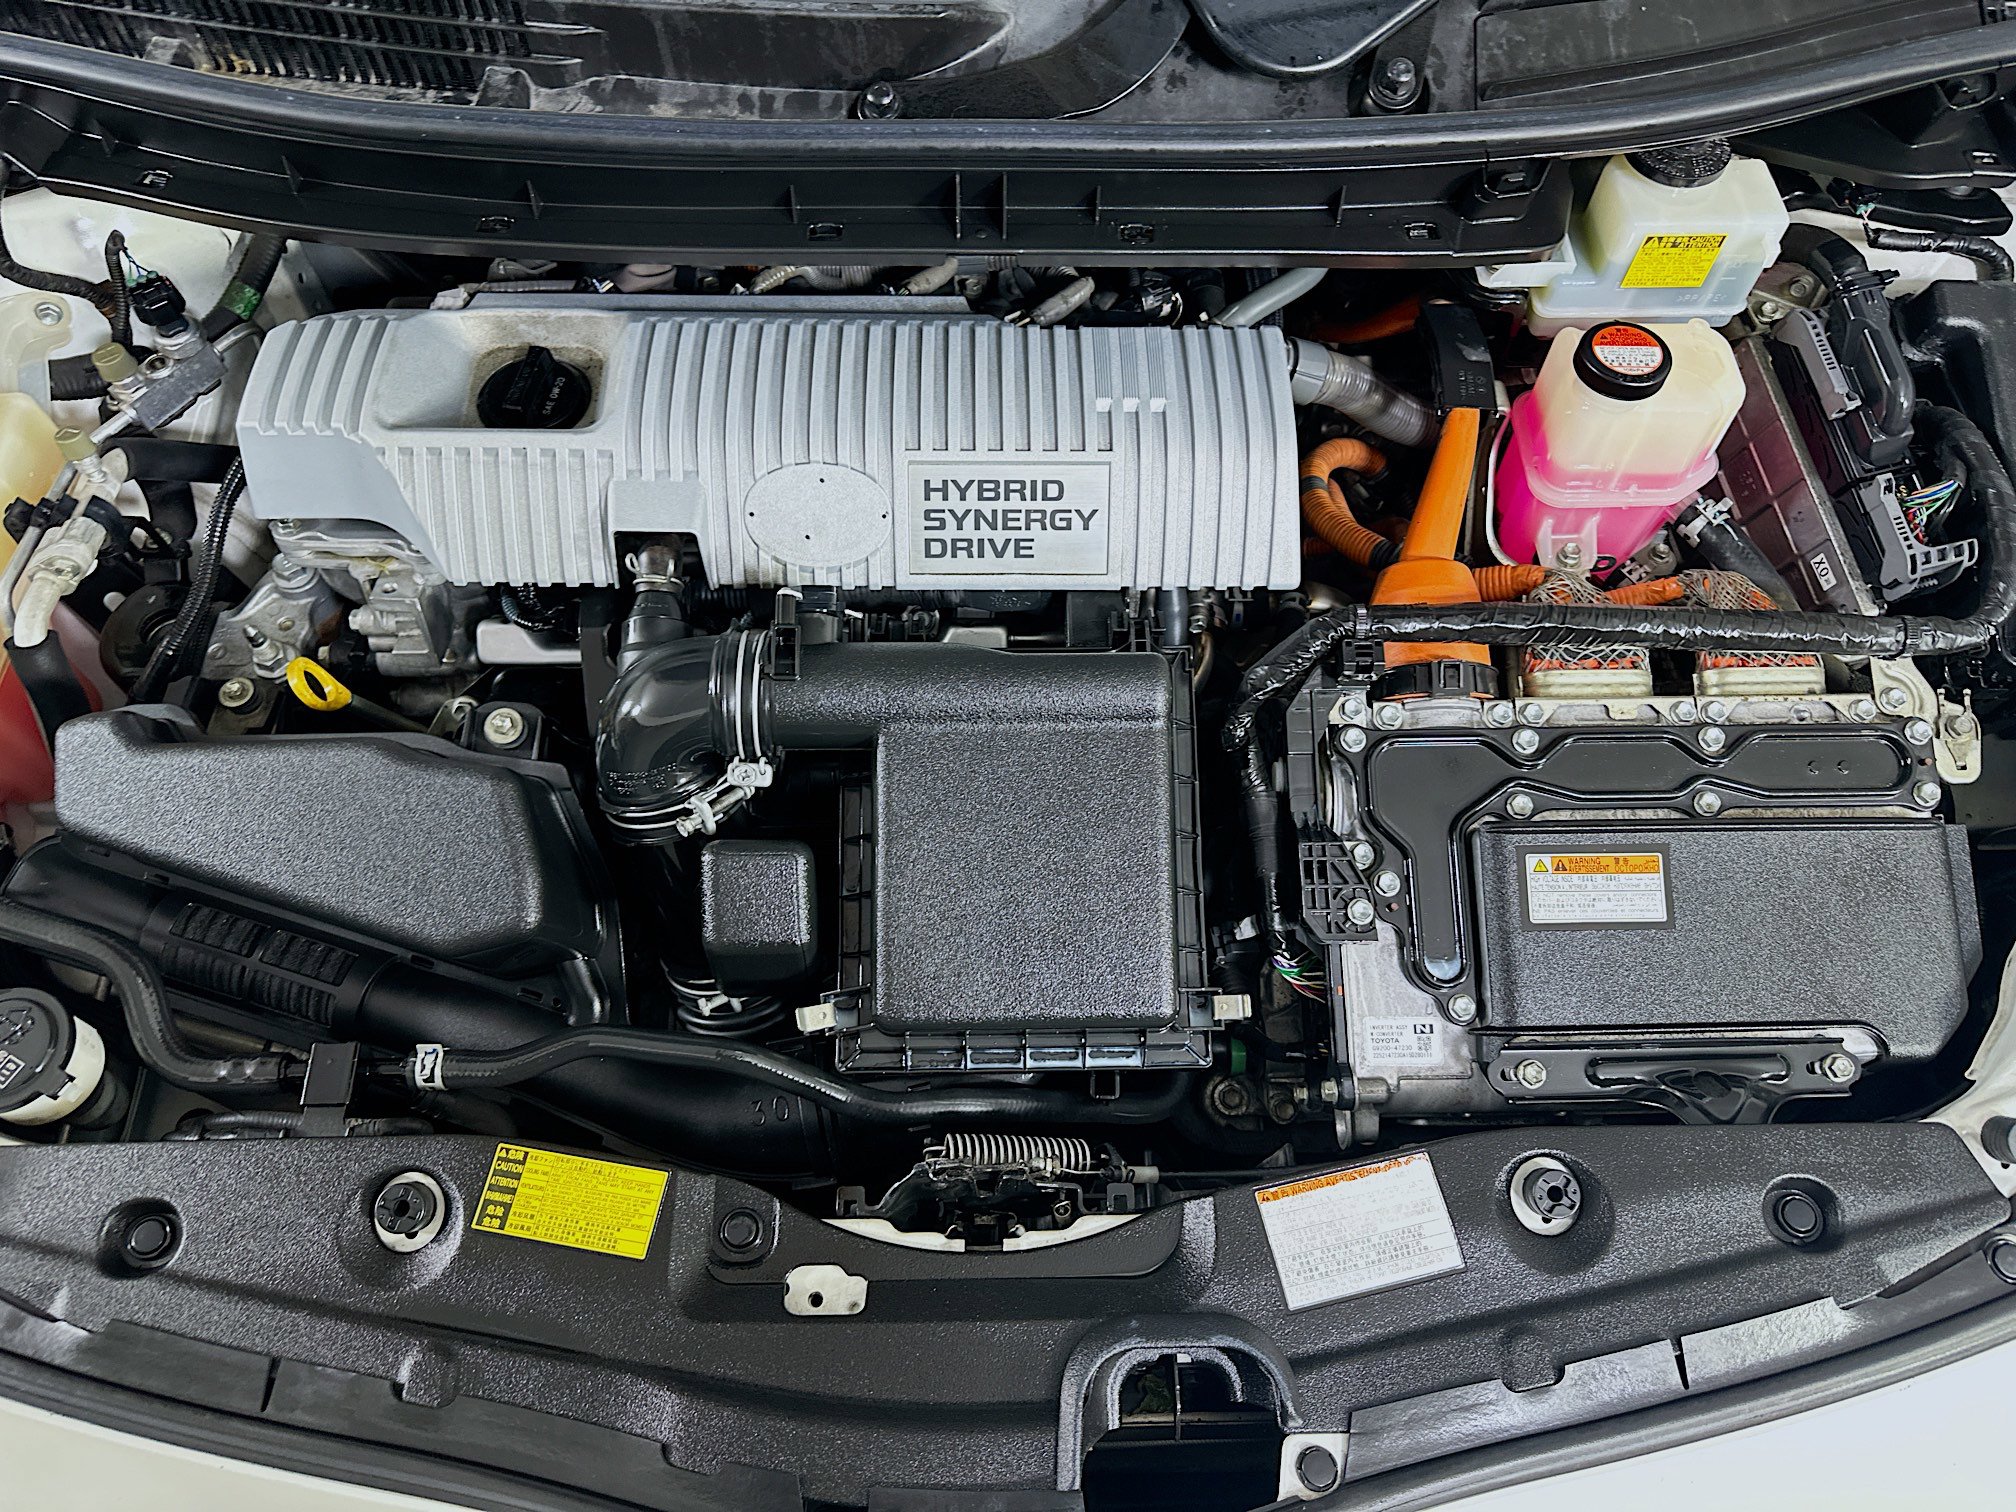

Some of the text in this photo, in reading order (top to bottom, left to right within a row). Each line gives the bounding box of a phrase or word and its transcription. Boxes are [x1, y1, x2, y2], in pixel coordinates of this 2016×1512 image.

[542, 376, 566, 416] SAE 0W-20
[923, 479, 1065, 502] HYBRID
[923, 508, 1099, 531] SYNERGY
[924, 538, 1035, 559] DRIVE
[1568, 857, 1601, 865] WARNING
[749, 1096, 789, 1126] 30
[495, 1161, 524, 1173] CAUTION
[490, 1176, 519, 1188] ATTENTION
[1292, 1180, 1324, 1196] WARNING
